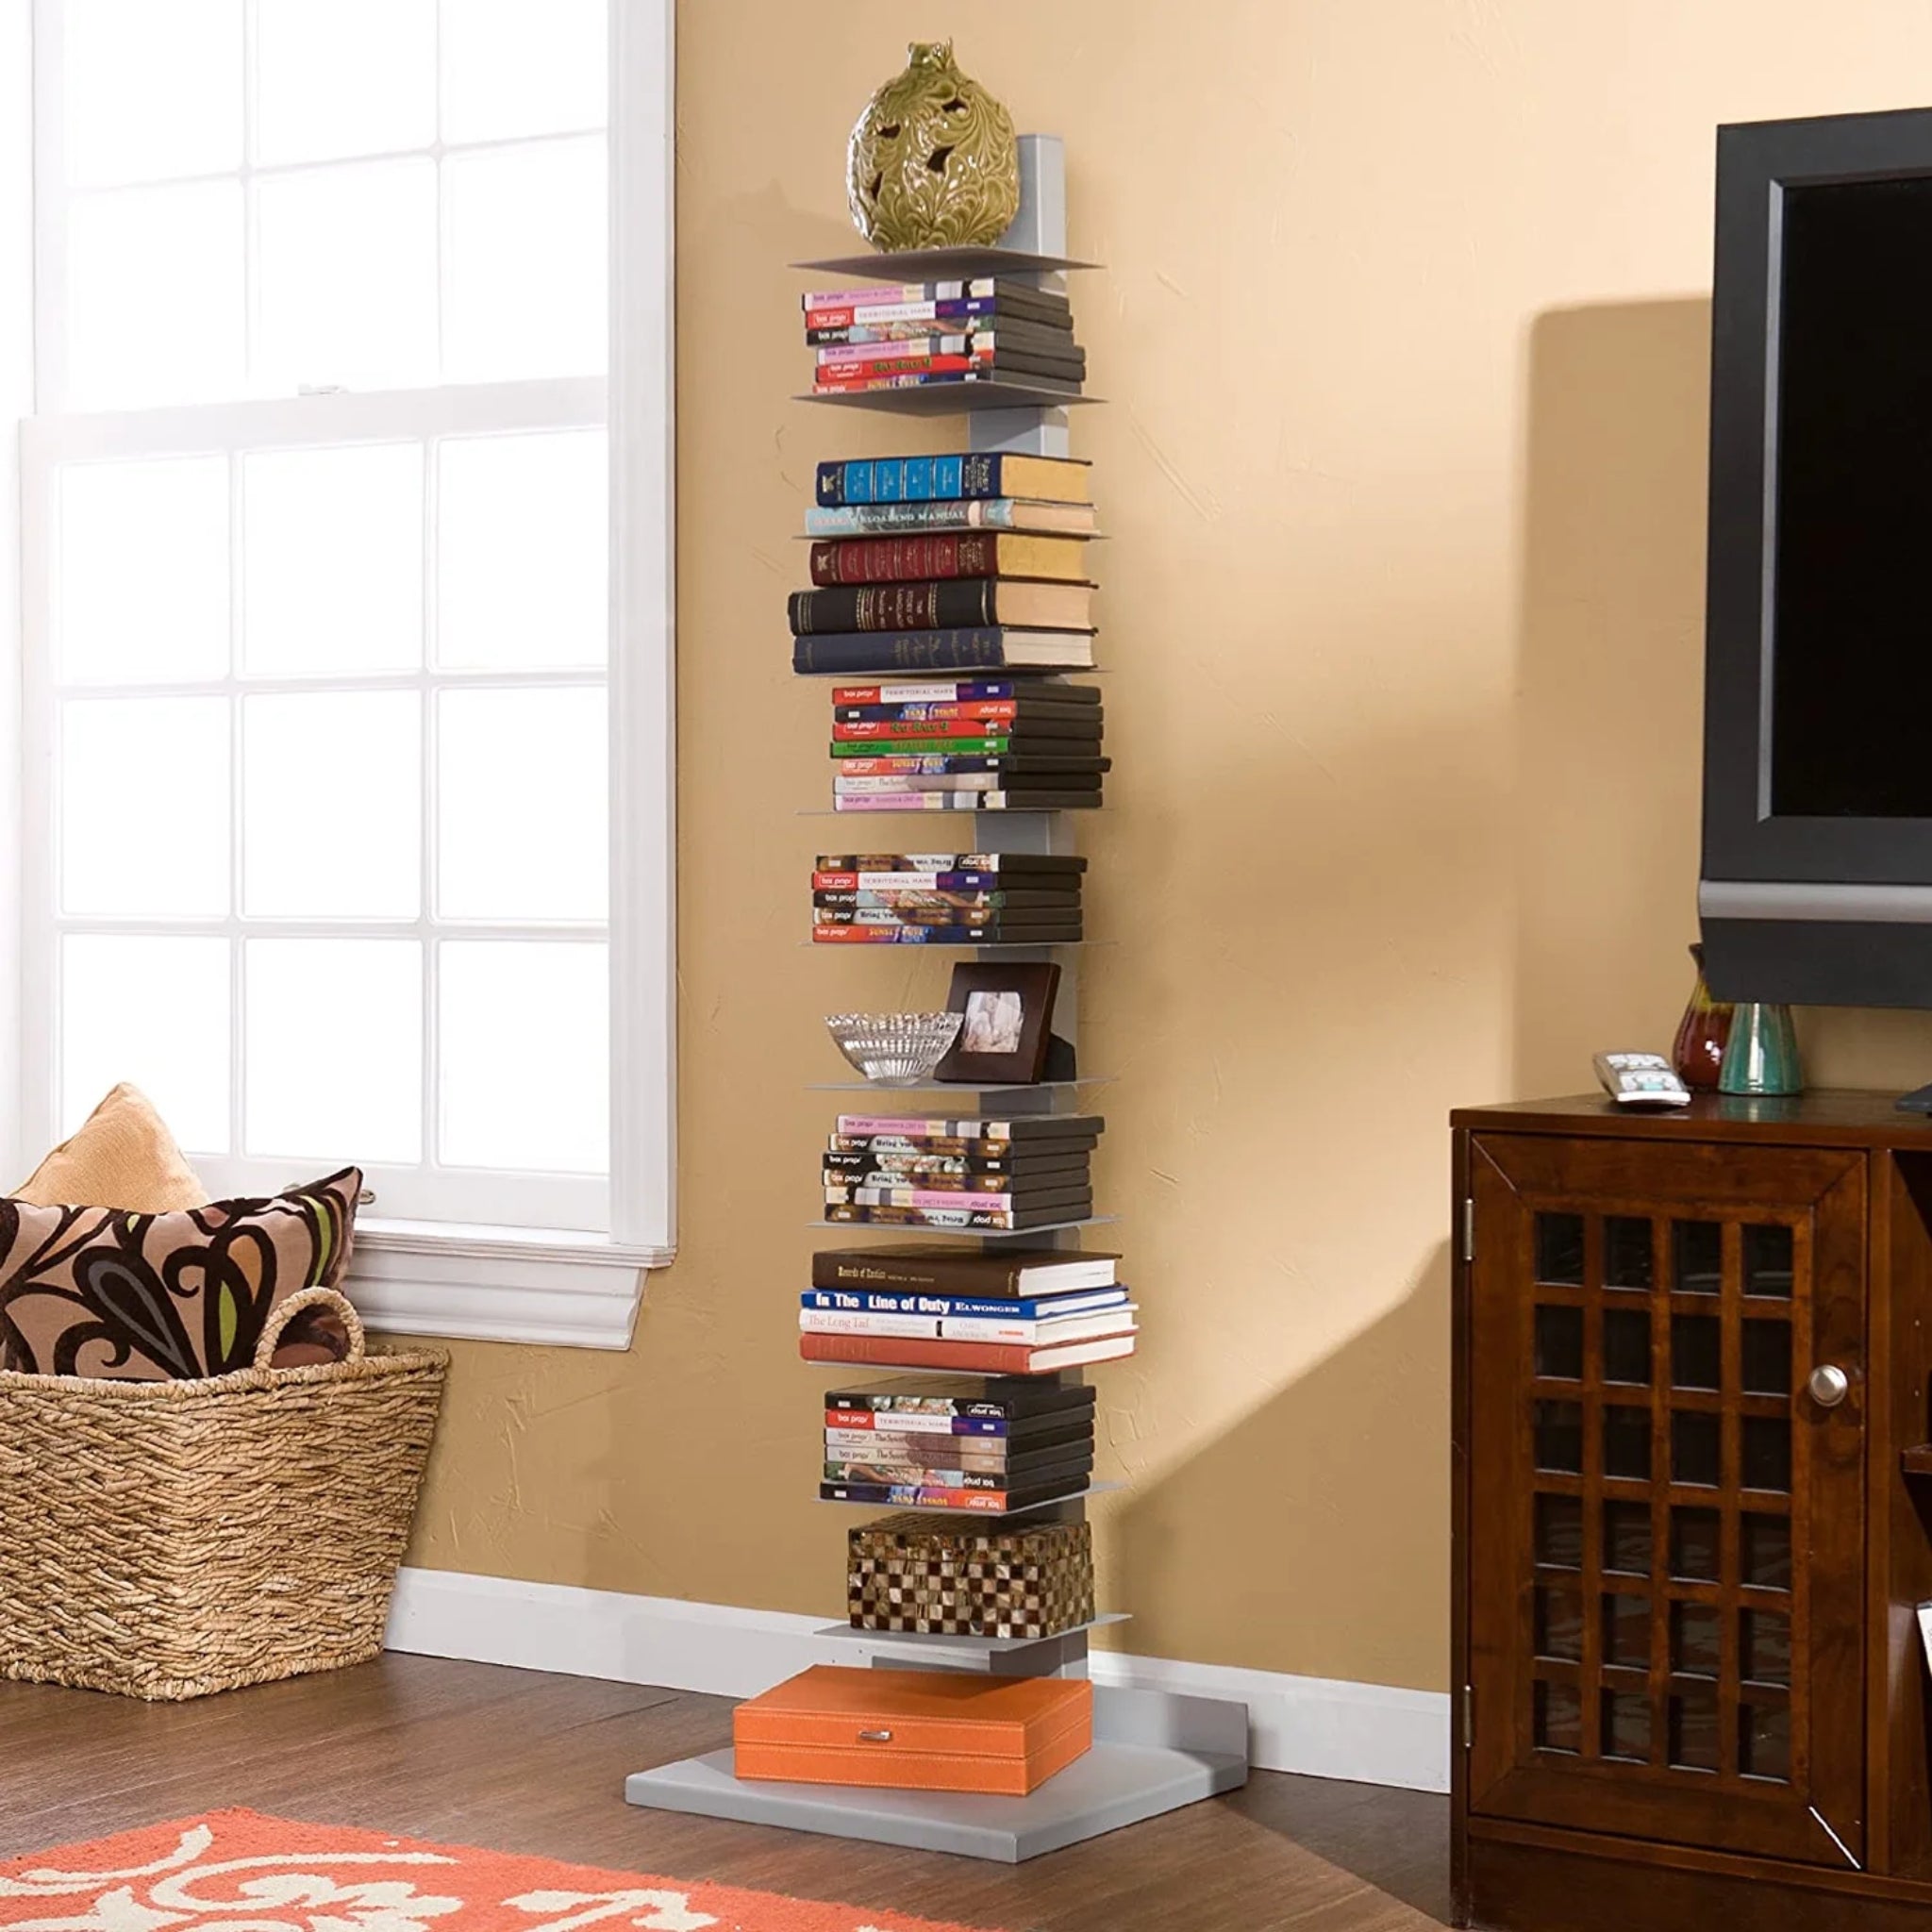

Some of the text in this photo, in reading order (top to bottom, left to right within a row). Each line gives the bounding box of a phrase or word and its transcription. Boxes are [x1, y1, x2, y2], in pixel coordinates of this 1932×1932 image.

[919, 511, 966, 521] MANUAL
[815, 1292, 950, 1314] In The Line of Duty
[808, 1316, 824, 1326] The
[827, 1317, 851, 1328] Long
[853, 1317, 869, 1328] Tail
